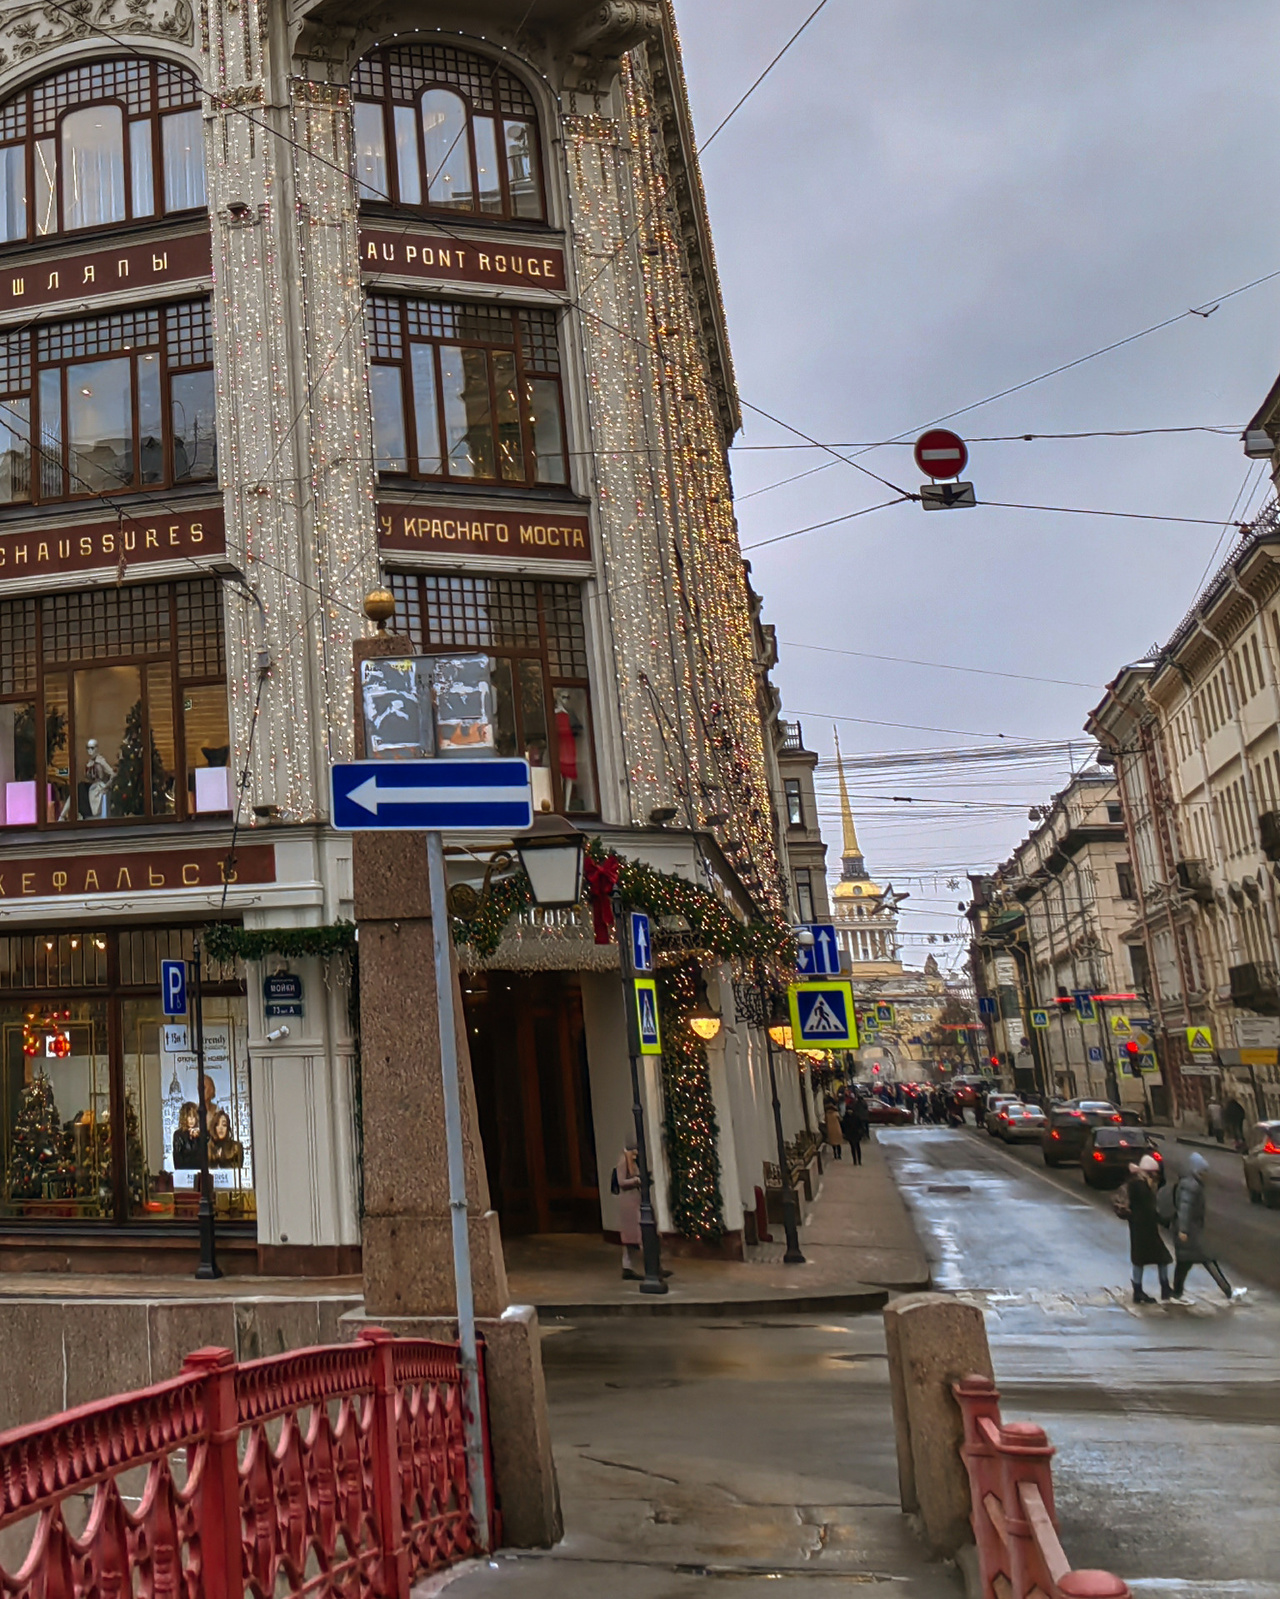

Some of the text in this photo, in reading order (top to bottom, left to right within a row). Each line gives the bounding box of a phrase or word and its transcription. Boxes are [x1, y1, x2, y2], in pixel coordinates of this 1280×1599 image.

[12, 251, 169, 297] ШЛЯПЫ
[367, 241, 556, 278] AU PONT ROUGE
[403, 517, 510, 545] КРАСНАГО
[519, 523, 585, 549] МОСТА
